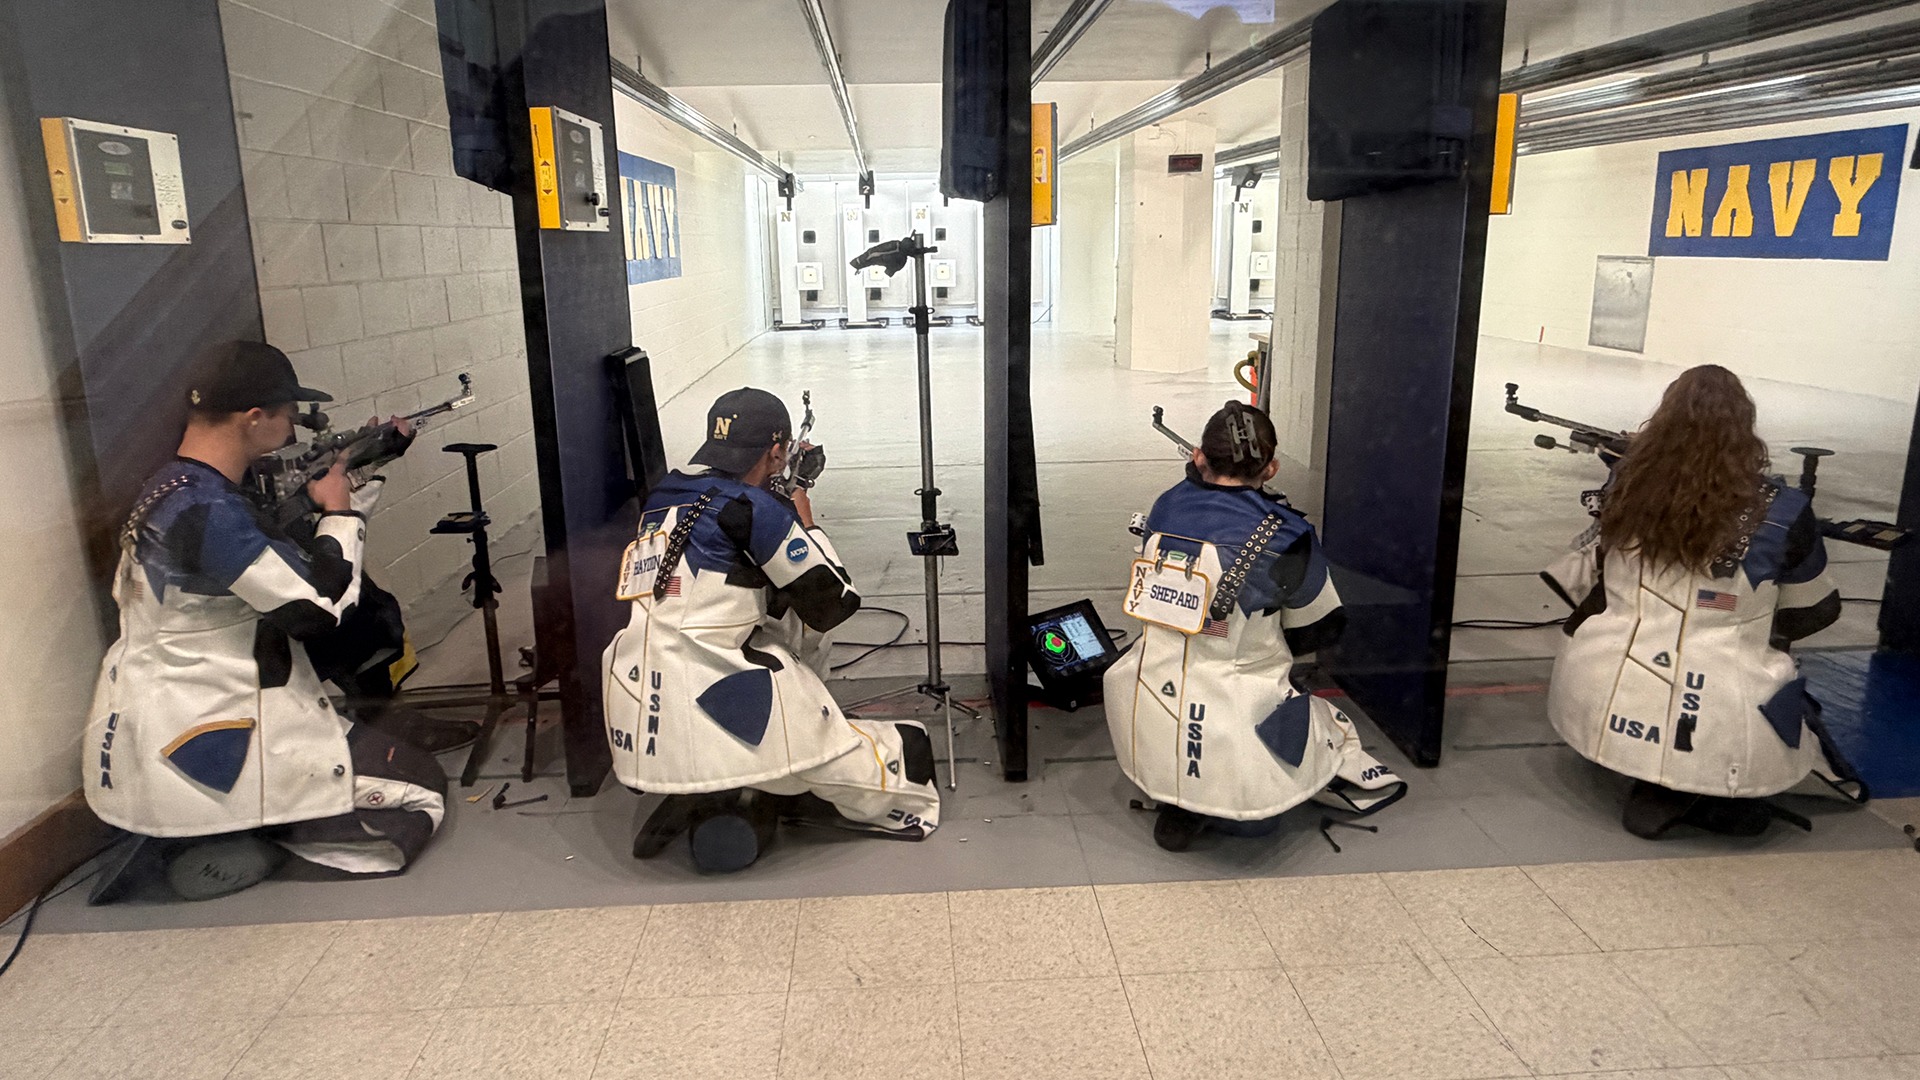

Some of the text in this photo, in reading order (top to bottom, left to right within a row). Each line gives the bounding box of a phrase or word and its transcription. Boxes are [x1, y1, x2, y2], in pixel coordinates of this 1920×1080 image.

[862, 185, 870, 194] 2
[1245, 180, 1255, 188] 6
[1665, 153, 1884, 237] NAVY
[780, 212, 791, 222] N
[1239, 203, 1249, 213] N
[714, 417, 732, 436] N
[1129, 566, 1147, 612] NAVY
[1150, 584, 1199, 610] SHEPARD
[646, 670, 662, 756] USNA
[1187, 703, 1205, 779] USNA
[1609, 713, 1660, 744] USA
[100, 712, 120, 789] USNA
